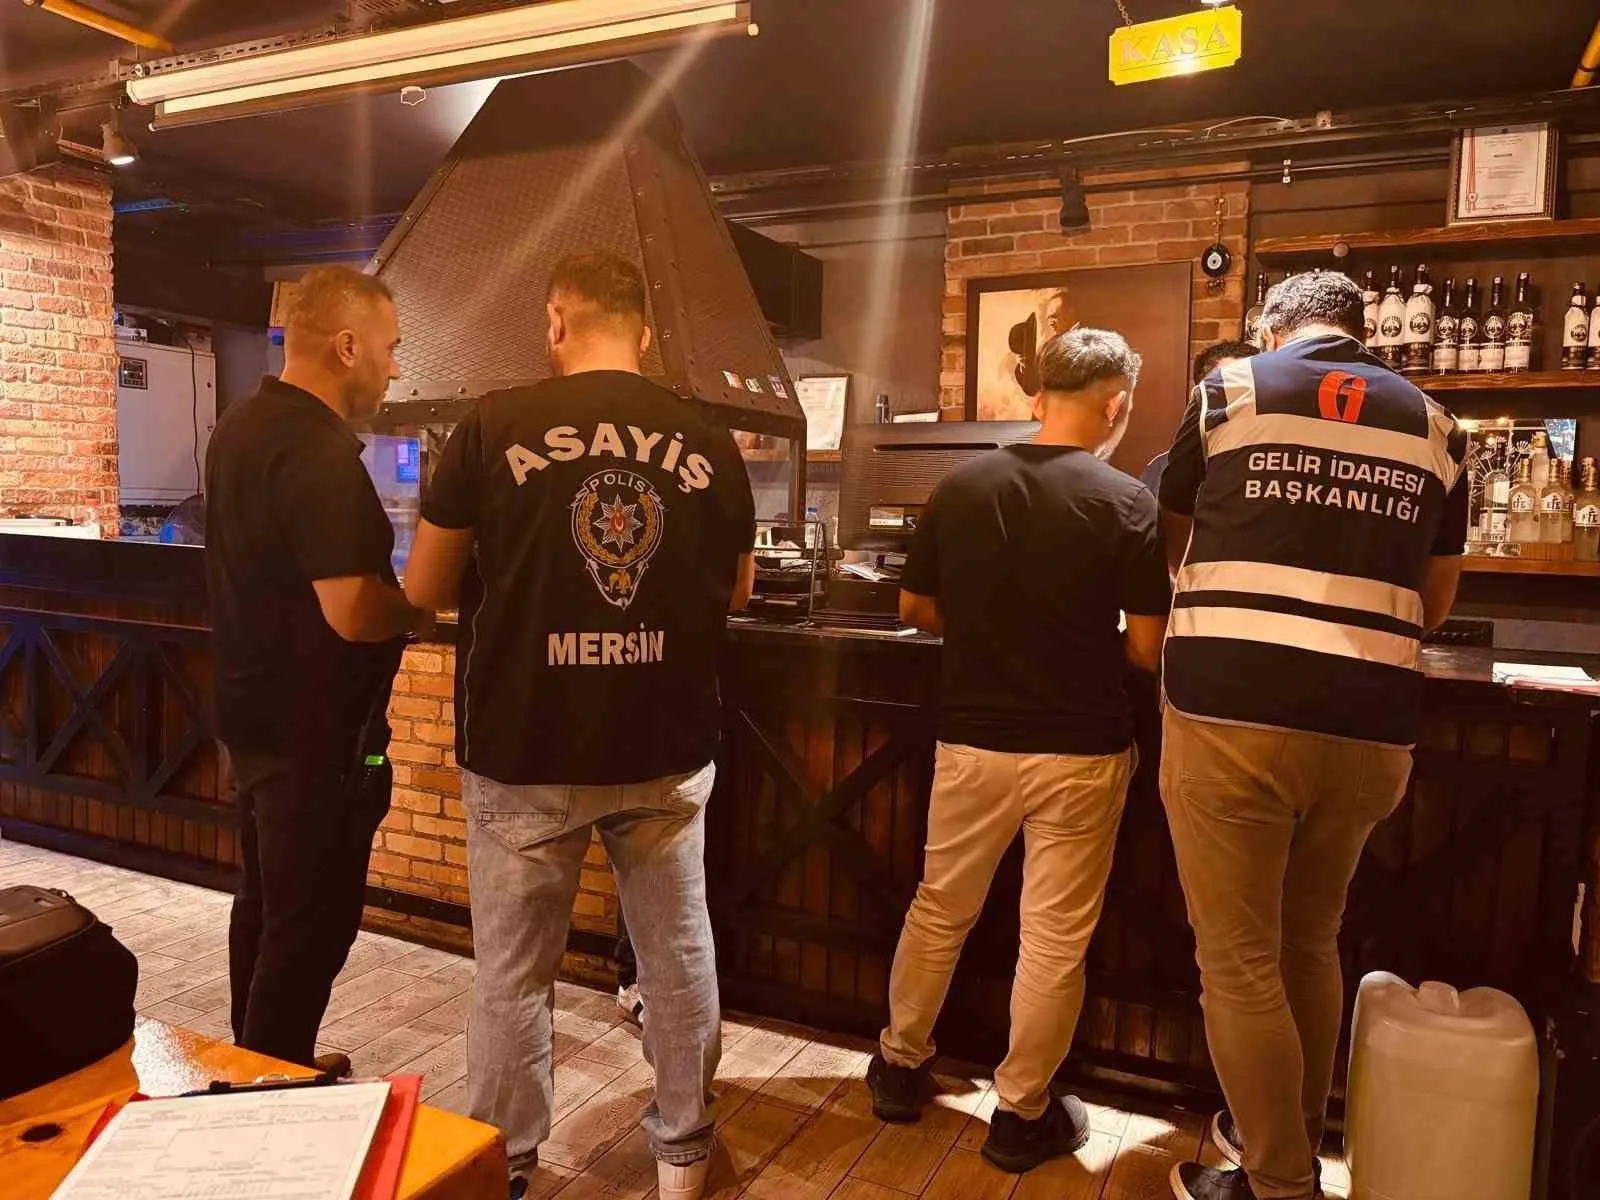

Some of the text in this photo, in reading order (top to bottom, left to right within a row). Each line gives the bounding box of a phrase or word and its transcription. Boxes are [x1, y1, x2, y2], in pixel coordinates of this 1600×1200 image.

[1120, 22, 1231, 66] KASA
[505, 422, 714, 494] ASAYİŞ
[1248, 449, 1426, 496] GELİR İDARESİ
[1244, 478, 1421, 524] BAŞKANLIĞI
[547, 622, 665, 666] MERSİN
